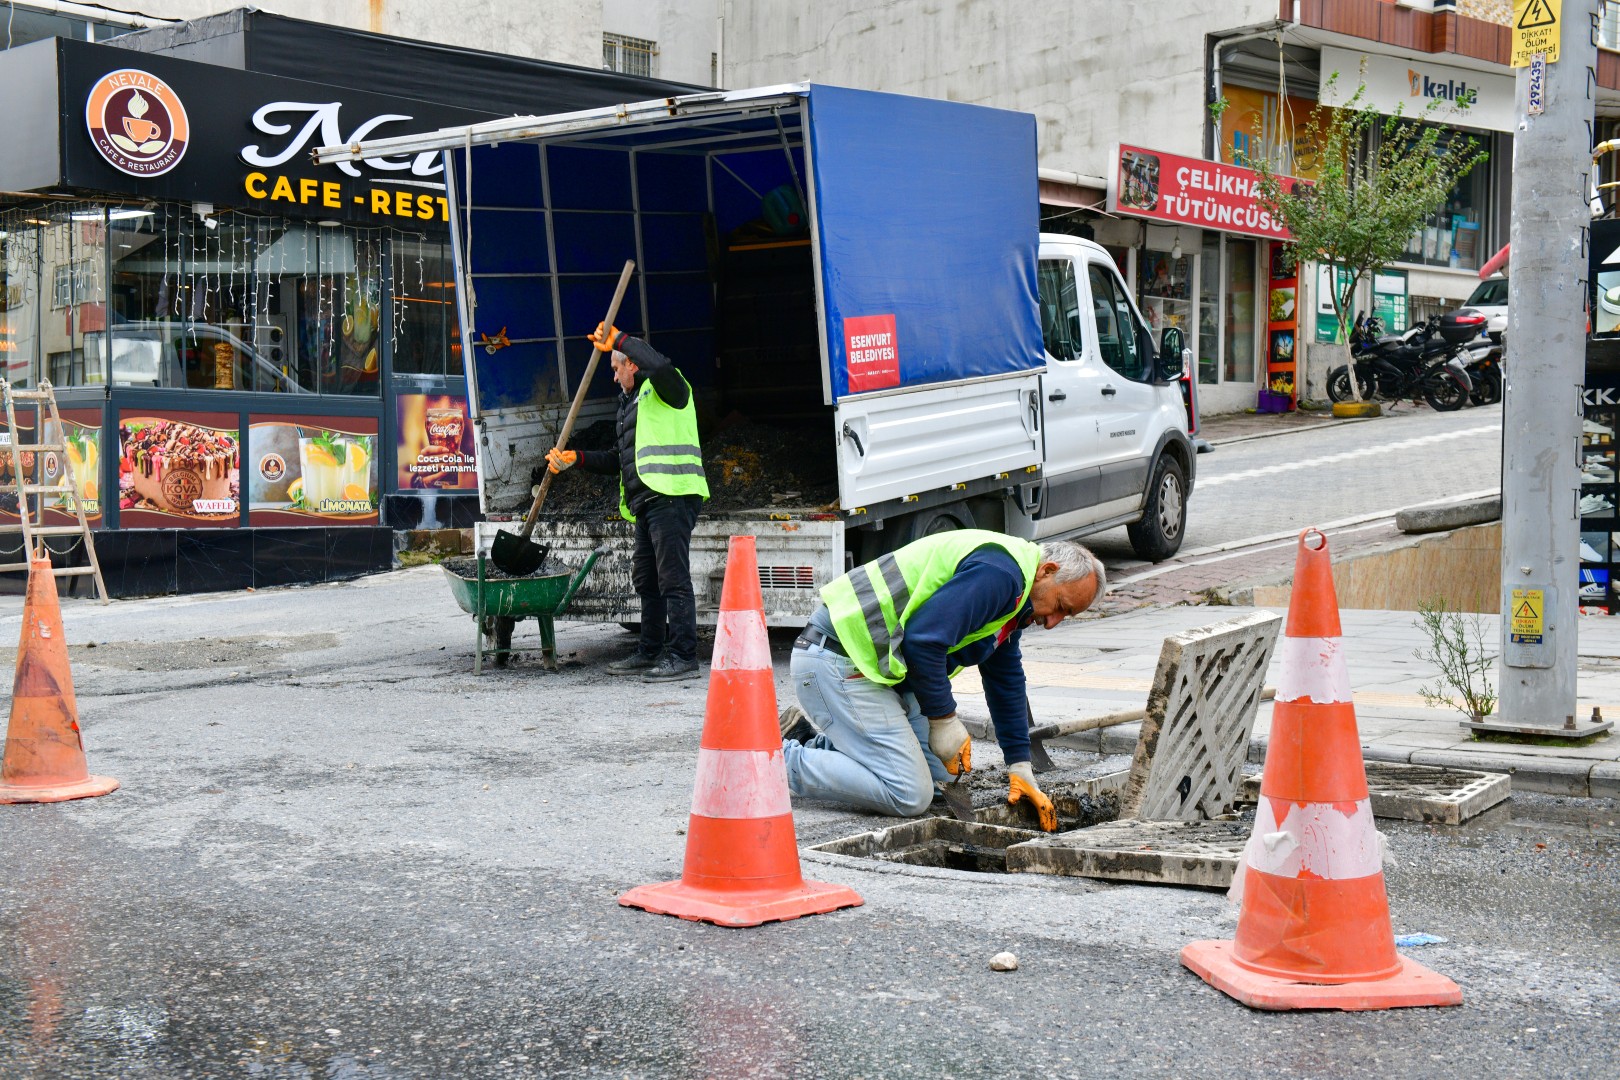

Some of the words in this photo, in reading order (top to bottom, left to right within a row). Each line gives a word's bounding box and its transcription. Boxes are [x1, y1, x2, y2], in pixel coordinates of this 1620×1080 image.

[1521, 28, 1552, 40] DİKKAT!
[1525, 38, 1547, 48] ÖLÜM
[108, 73, 165, 96] NEVALE
[1530, 60, 1542, 106] 292435
[99, 139, 119, 161] CAFE
[118, 157, 126, 165] &
[127, 148, 178, 172] RESTAURANT
[244, 171, 342, 209] CAFE
[1176, 166, 1267, 199] ÇELİKHA
[850, 332, 892, 349] ESENYURT
[850, 346, 895, 364] BELEDİYESİ
[417, 454, 463, 463] Coca-Cola
[464, 454, 475, 463] ile
[409, 463, 439, 473] lezzeti
[166, 485, 198, 494] KOVA
[195, 502, 233, 510] WAFFLE
[320, 498, 372, 512] LİMONATA
